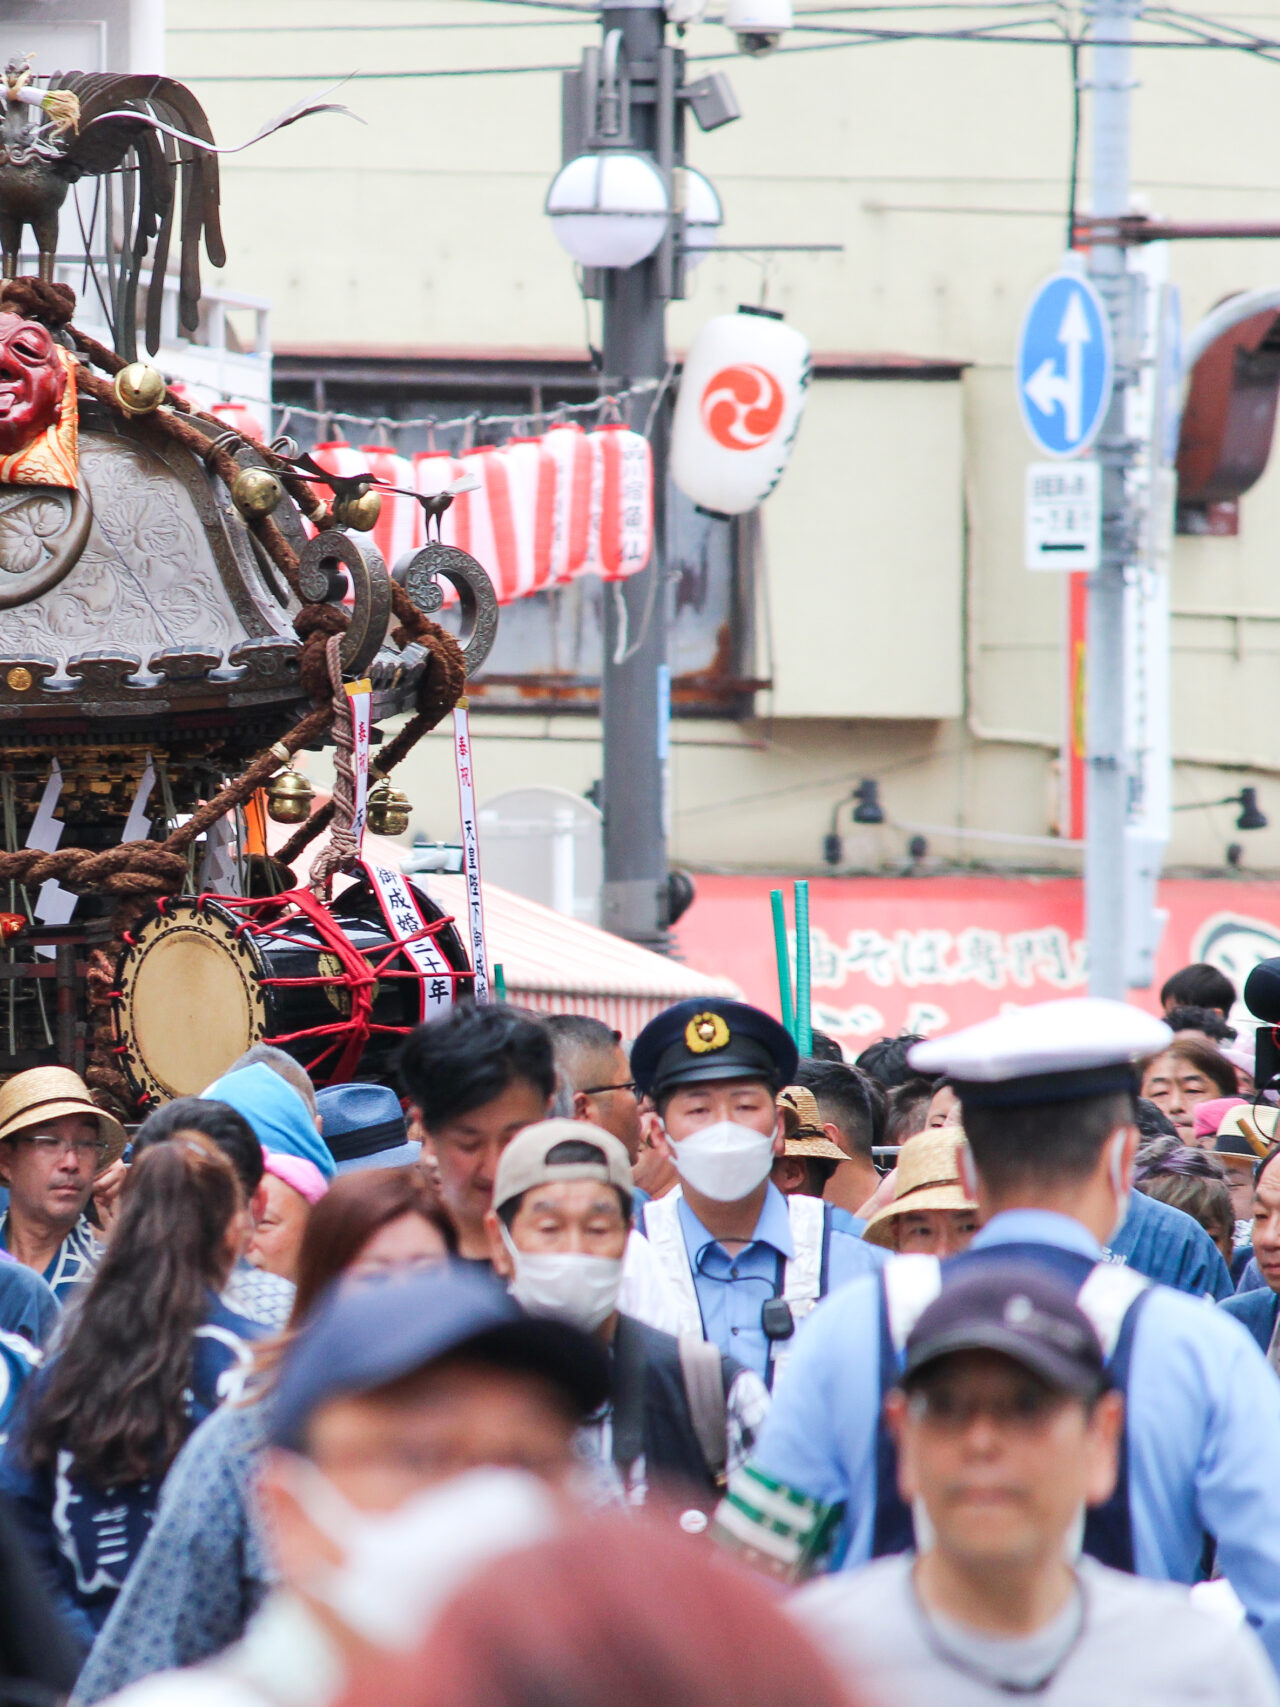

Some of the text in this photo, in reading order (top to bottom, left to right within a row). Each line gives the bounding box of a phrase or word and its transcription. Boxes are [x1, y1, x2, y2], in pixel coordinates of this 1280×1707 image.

[789, 930, 1089, 982] 油そば専門
